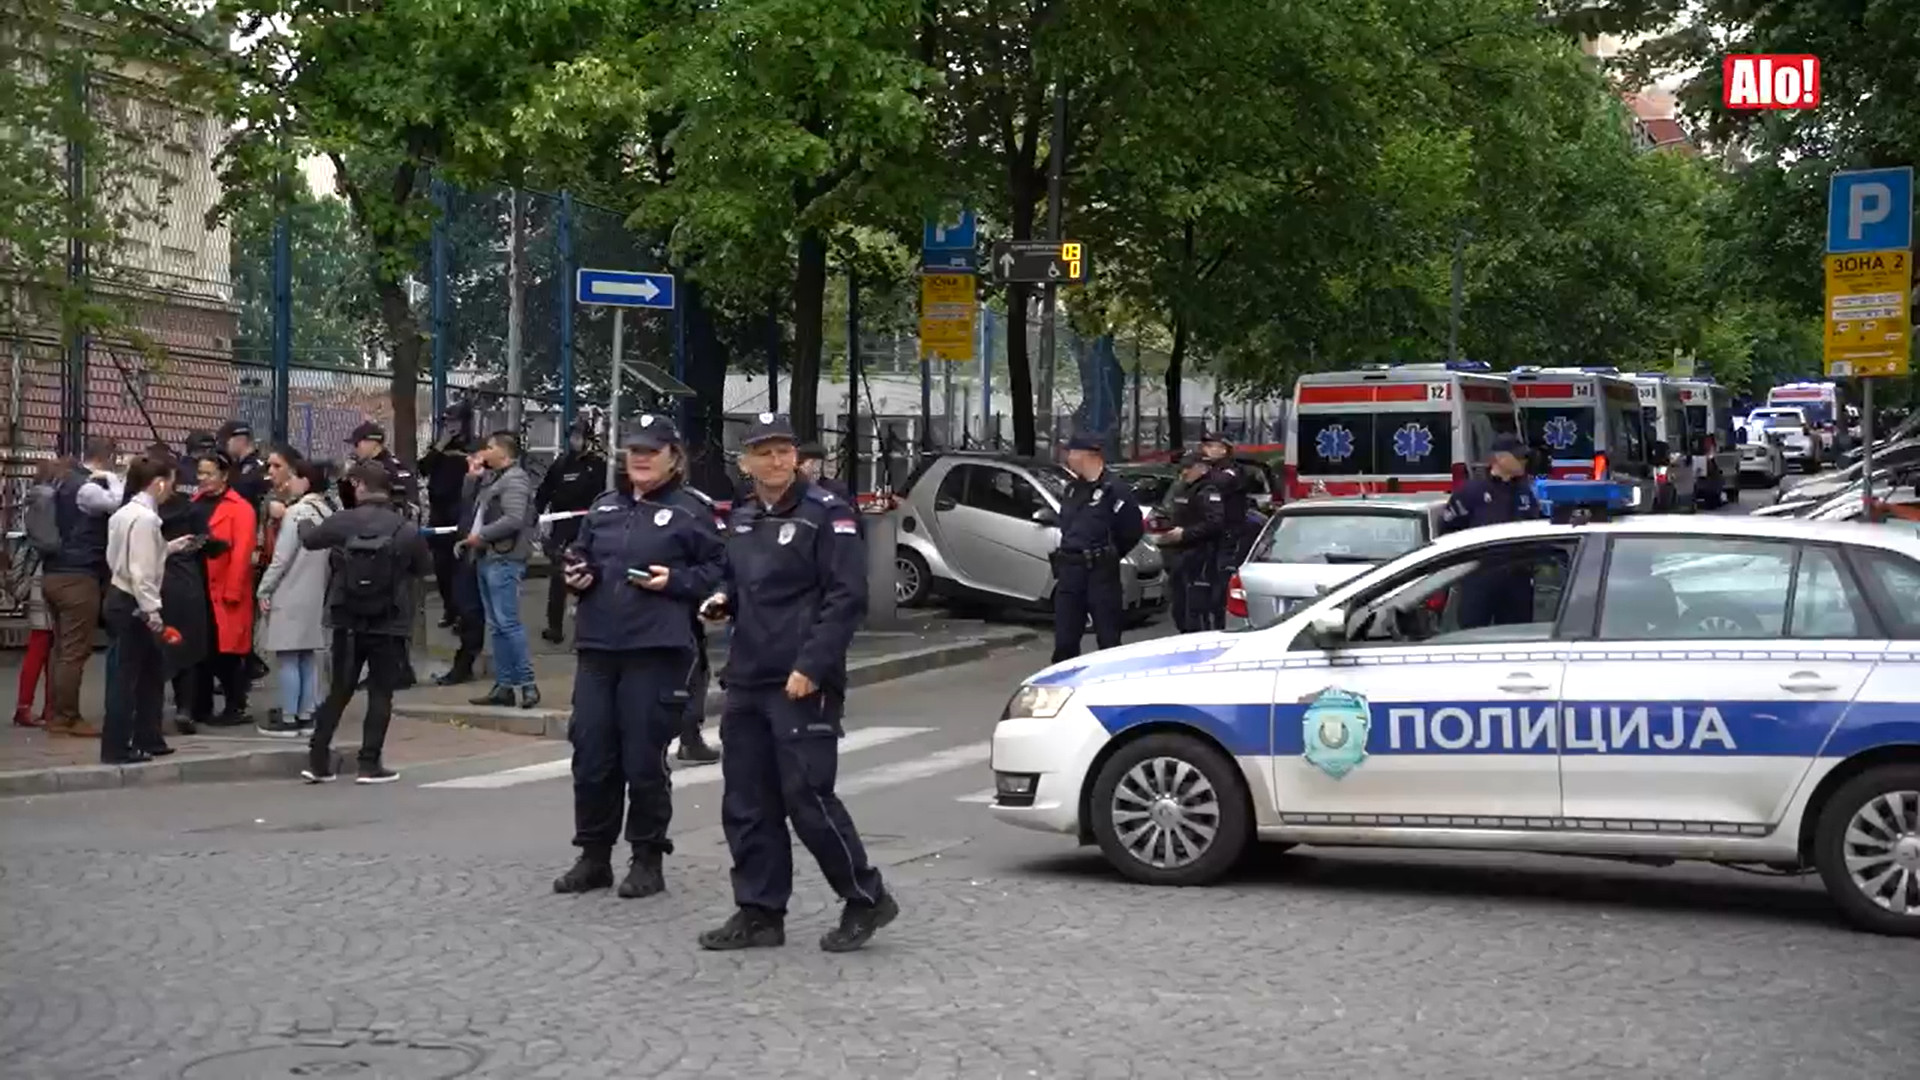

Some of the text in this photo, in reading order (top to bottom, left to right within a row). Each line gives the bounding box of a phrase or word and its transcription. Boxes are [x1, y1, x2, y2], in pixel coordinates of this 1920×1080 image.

[1848, 182, 1891, 240] P
[1070, 261, 1080, 278] 0
[1833, 254, 1904, 273] ЗОНА 2
[1431, 385, 1445, 399] 12
[1388, 706, 1737, 752] ПОЛИЦИЈА
